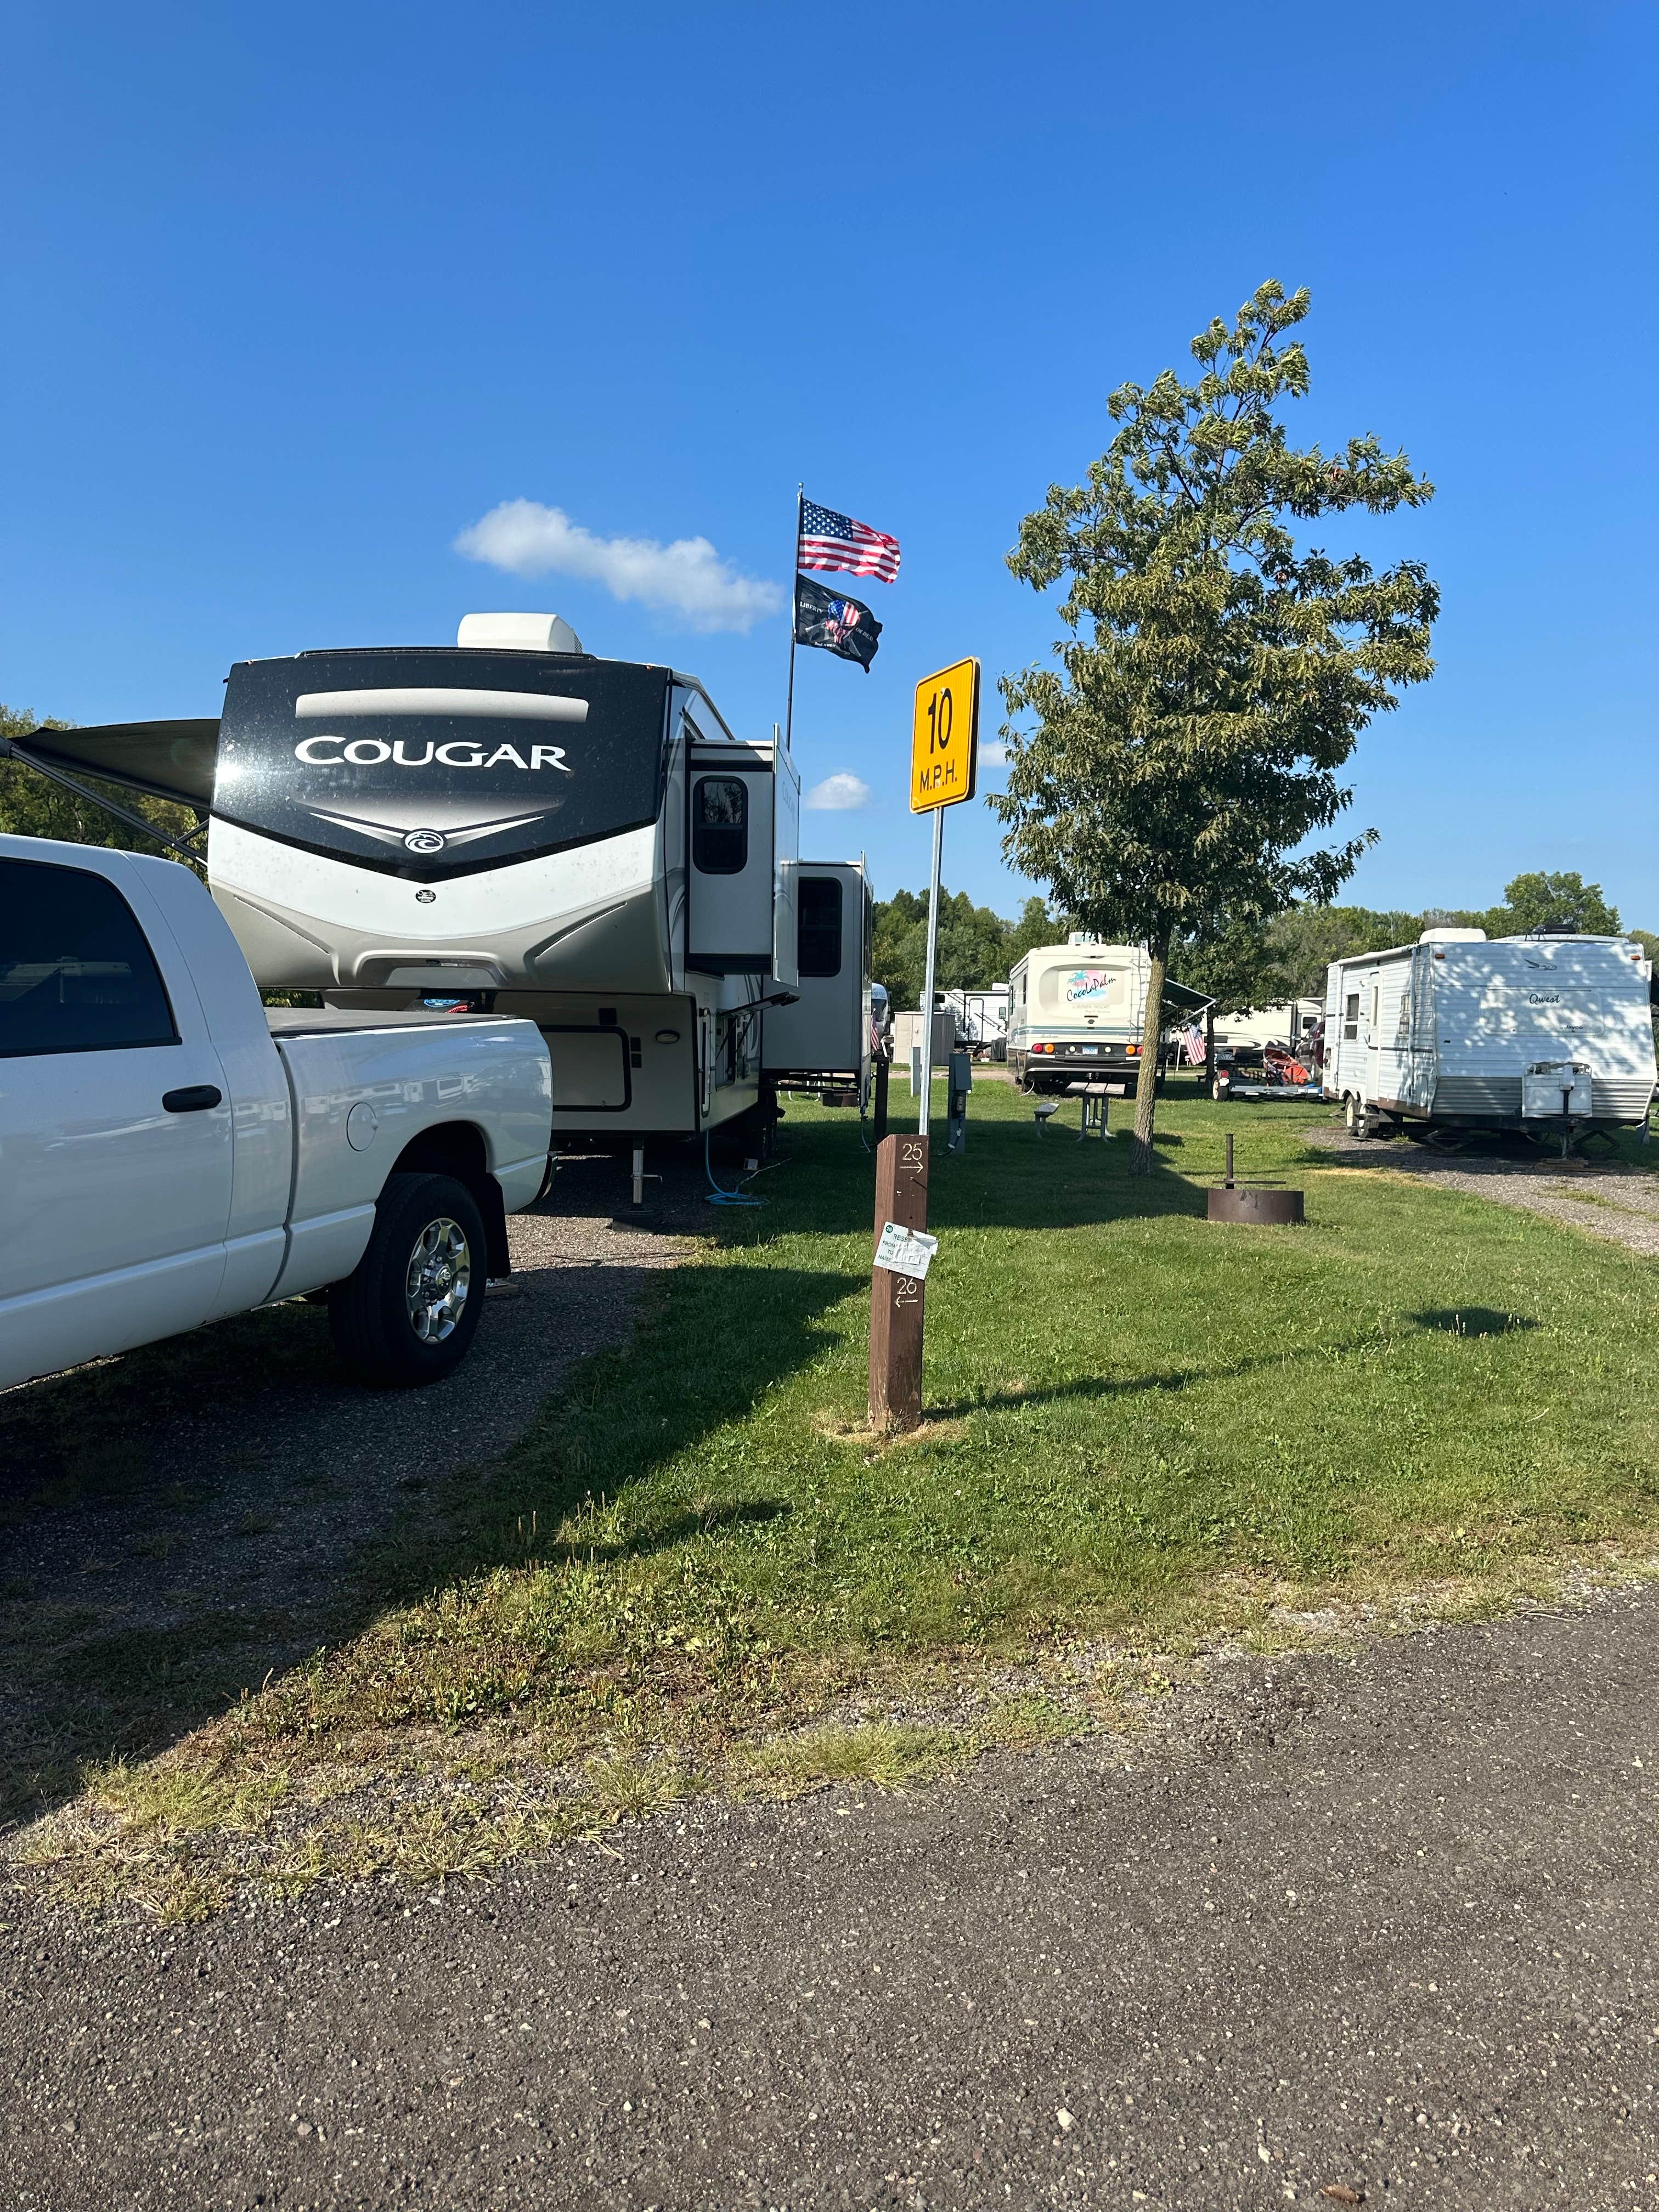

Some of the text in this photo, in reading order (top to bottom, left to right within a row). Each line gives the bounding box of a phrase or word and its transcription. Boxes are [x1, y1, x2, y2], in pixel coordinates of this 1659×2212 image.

[800, 601, 823, 613] LIBERTY
[928, 687, 952, 754] 10
[295, 736, 571, 771] COUGAR
[920, 759, 957, 793] M.P.H.
[1529, 993, 1561, 1005] Qwest
[902, 1142, 922, 1160] 25
[896, 1277, 917, 1294] 26
